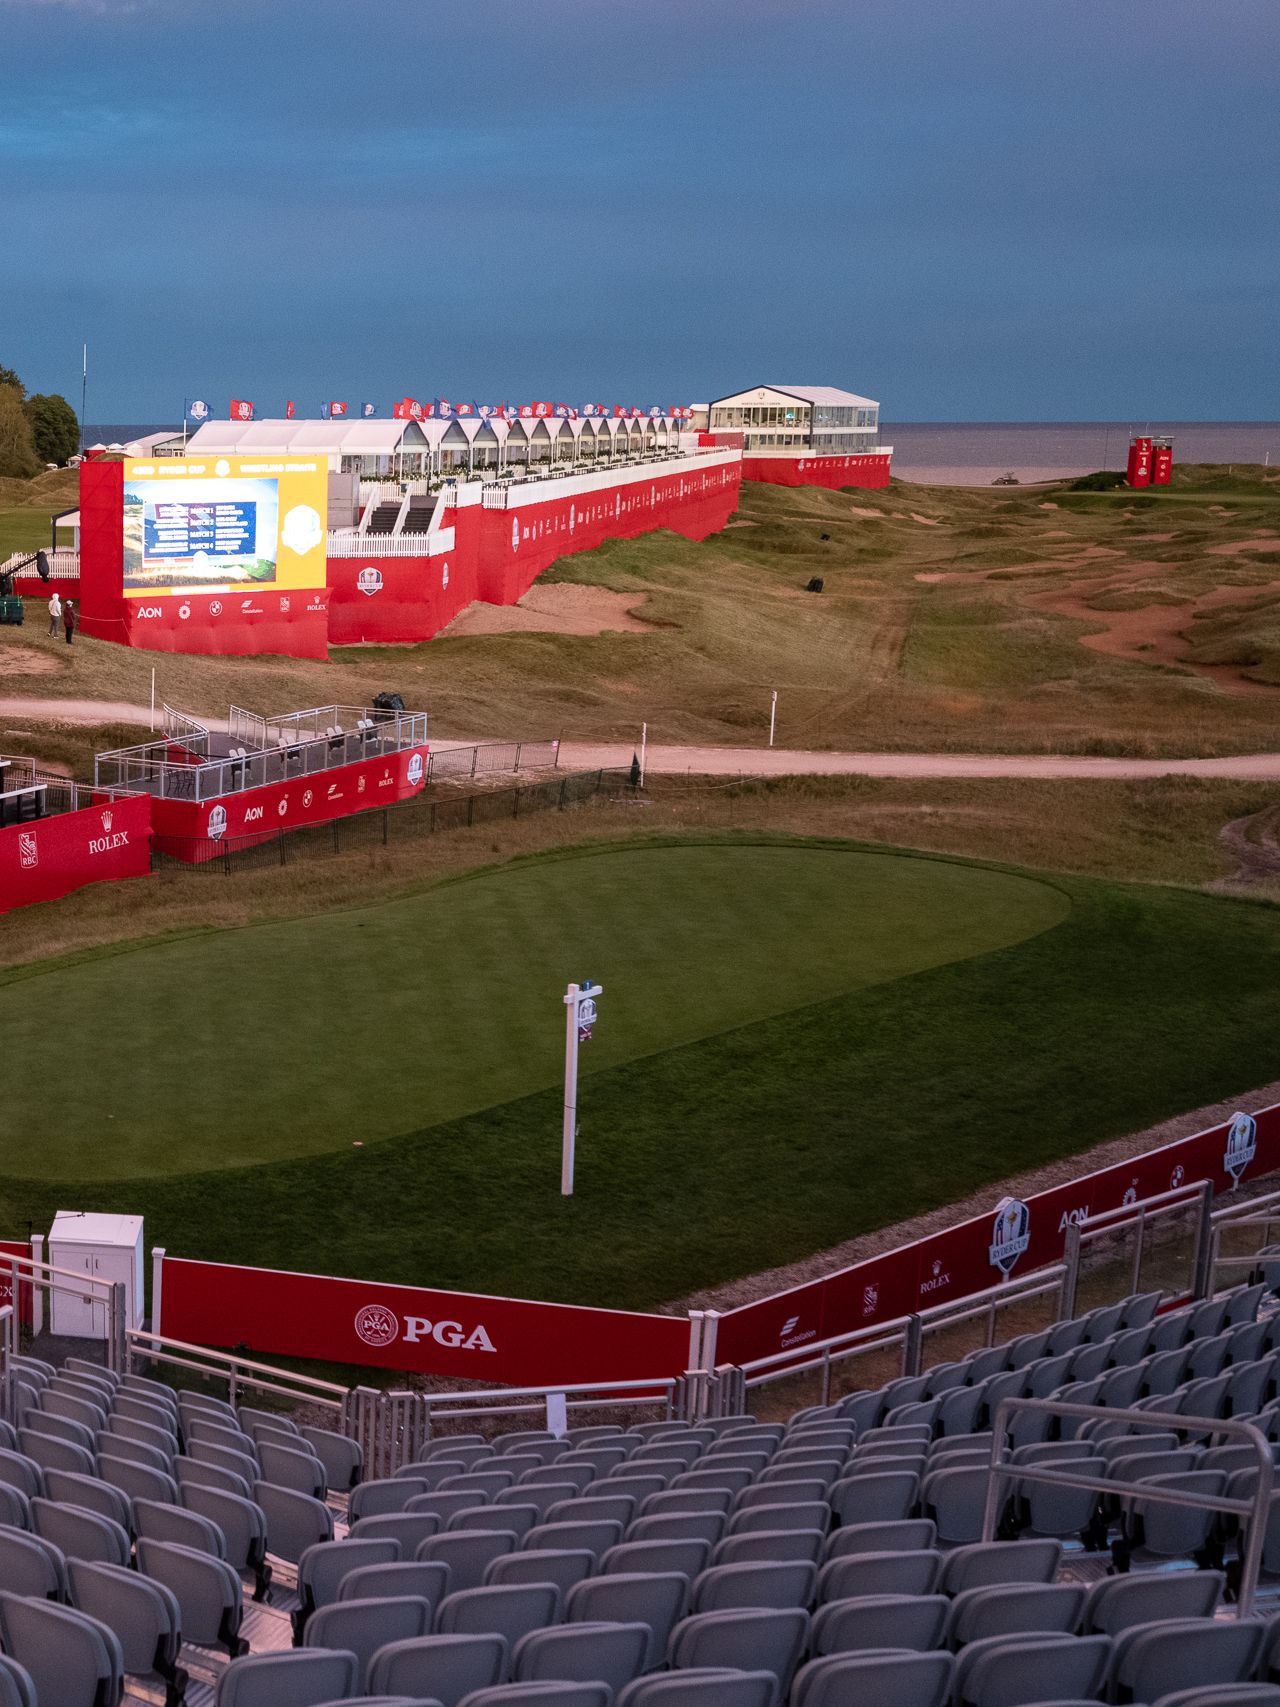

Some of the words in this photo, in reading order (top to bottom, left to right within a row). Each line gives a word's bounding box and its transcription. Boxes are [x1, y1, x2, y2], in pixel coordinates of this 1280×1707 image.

[137, 606, 162, 618] AON
[244, 806, 264, 822] AON
[88, 831, 130, 855] ROLEX
[22, 855, 37, 866] RBC
[992, 1243, 1014, 1260] RYDER
[1013, 1237, 1028, 1251] CUP
[920, 1272, 950, 1294] ROLEX
[363, 1320, 390, 1331] PGA
[402, 1316, 498, 1353] PGA
[780, 1329, 817, 1349] Constellation
